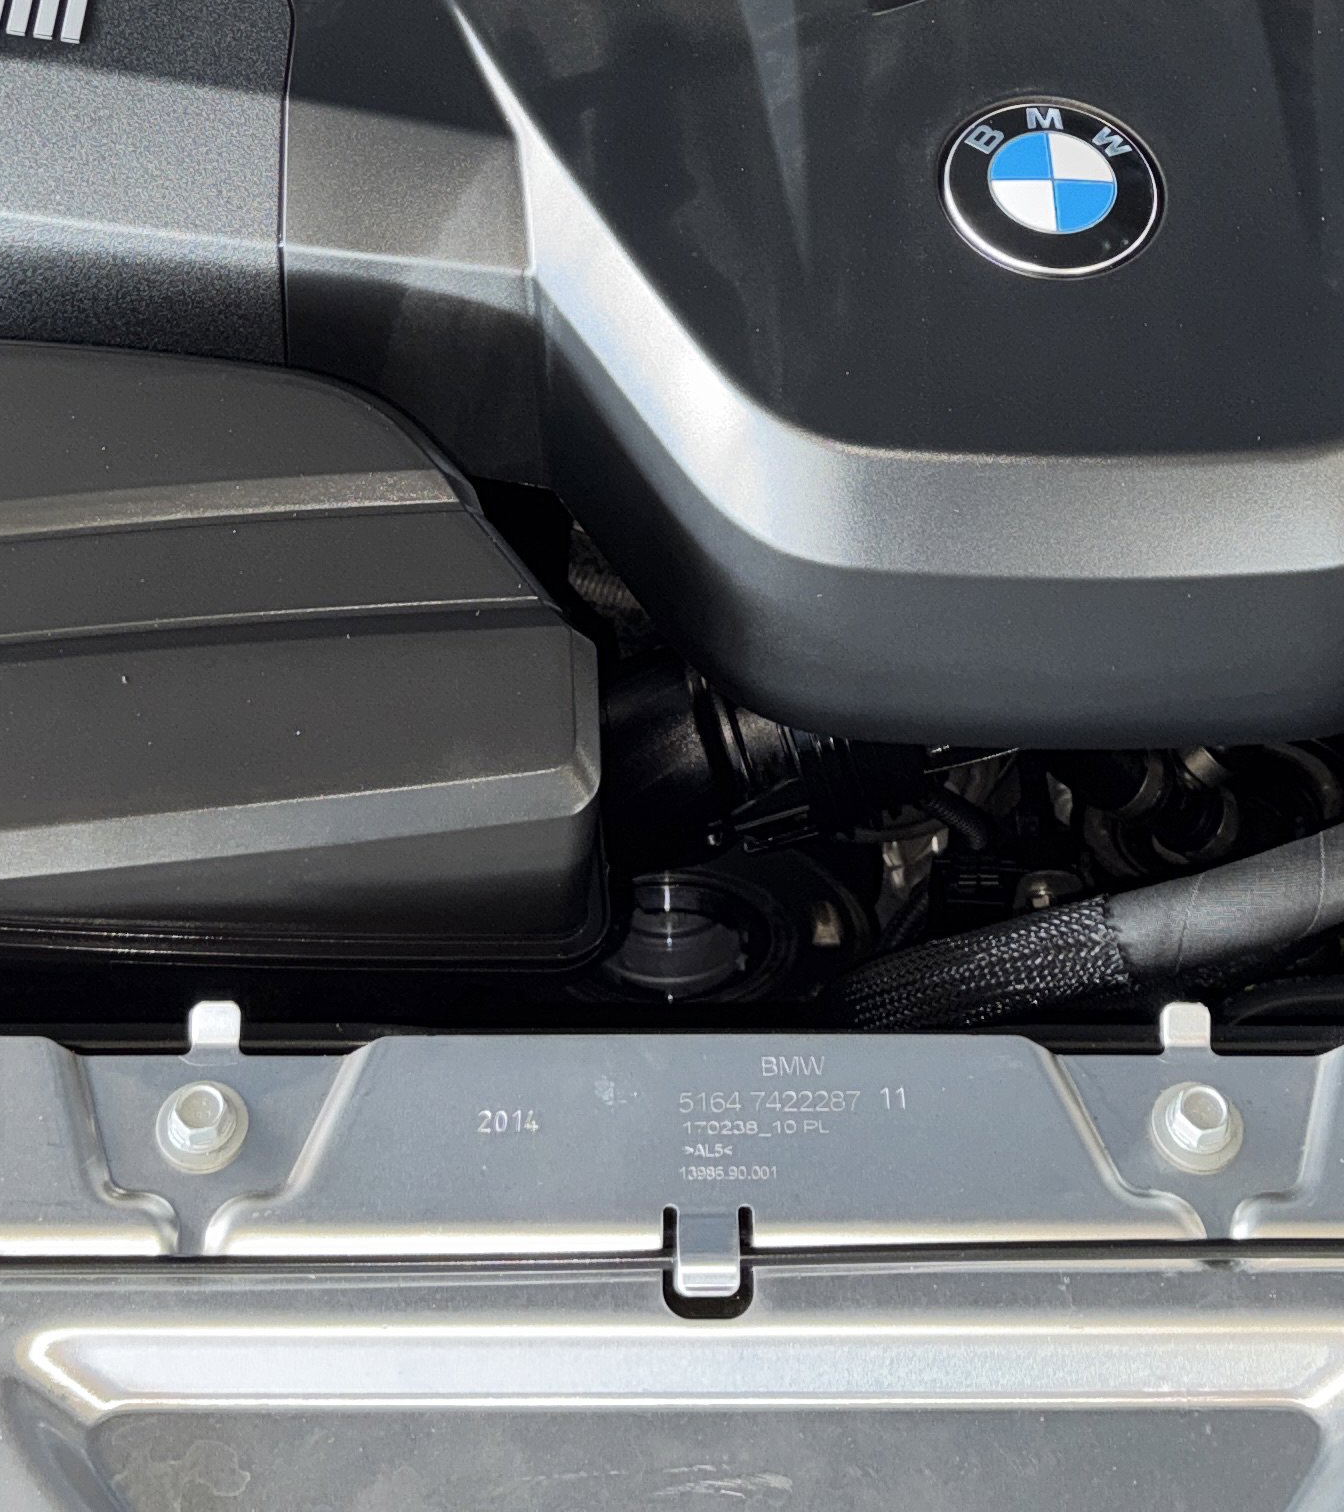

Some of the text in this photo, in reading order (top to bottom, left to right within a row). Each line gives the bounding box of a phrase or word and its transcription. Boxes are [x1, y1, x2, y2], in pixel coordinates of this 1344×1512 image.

[964, 107, 1132, 158] BMW
[761, 1056, 825, 1077] BMW
[679, 1086, 906, 1113] 5164 7422287 11
[477, 1109, 539, 1133] 2014
[803, 1119, 830, 1134] PL
